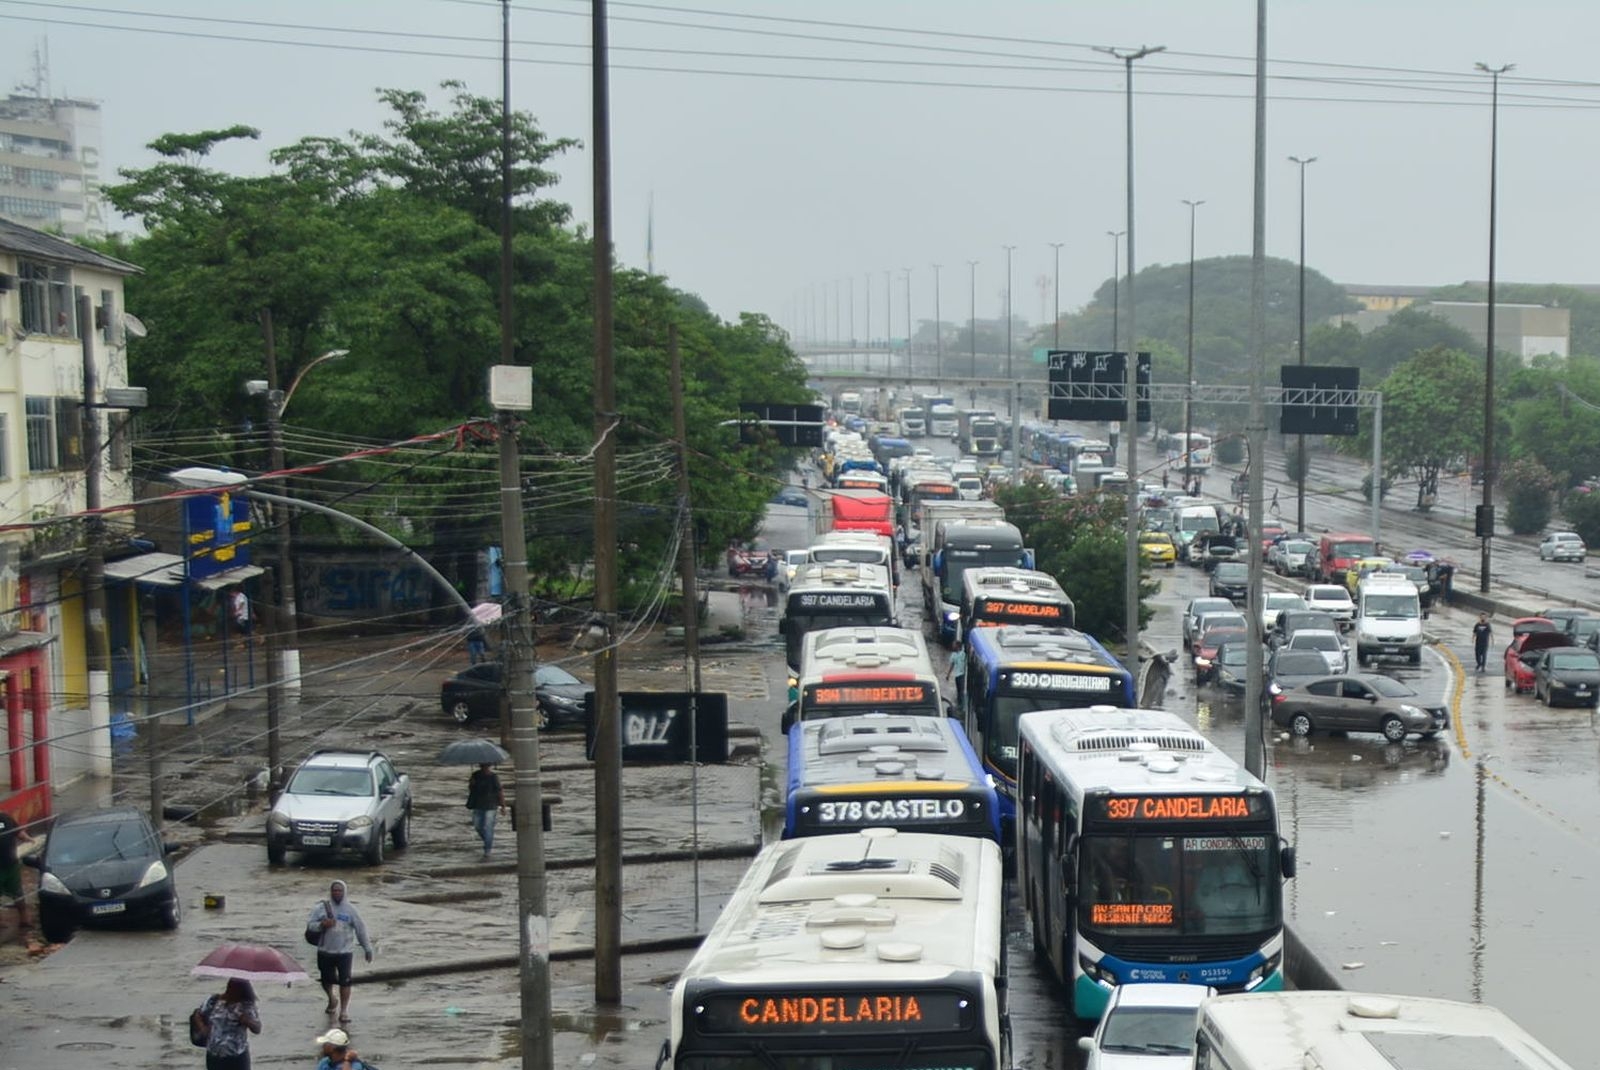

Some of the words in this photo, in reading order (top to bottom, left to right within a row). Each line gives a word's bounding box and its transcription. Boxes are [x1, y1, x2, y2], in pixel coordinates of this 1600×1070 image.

[801, 594, 818, 606] 397
[820, 594, 875, 606] CANDELARIA
[986, 602, 1004, 613] 397
[1007, 604, 1059, 617] CANDELARIA
[1013, 672, 1037, 687] 300
[820, 801, 862, 820] 378
[865, 799, 964, 819] CASTELO
[1108, 799, 1139, 819] 397
[1143, 798, 1249, 818] CANDELARIA
[1201, 839, 1265, 849] CONDICIONADO
[740, 996, 921, 1024] CANDELARIA
